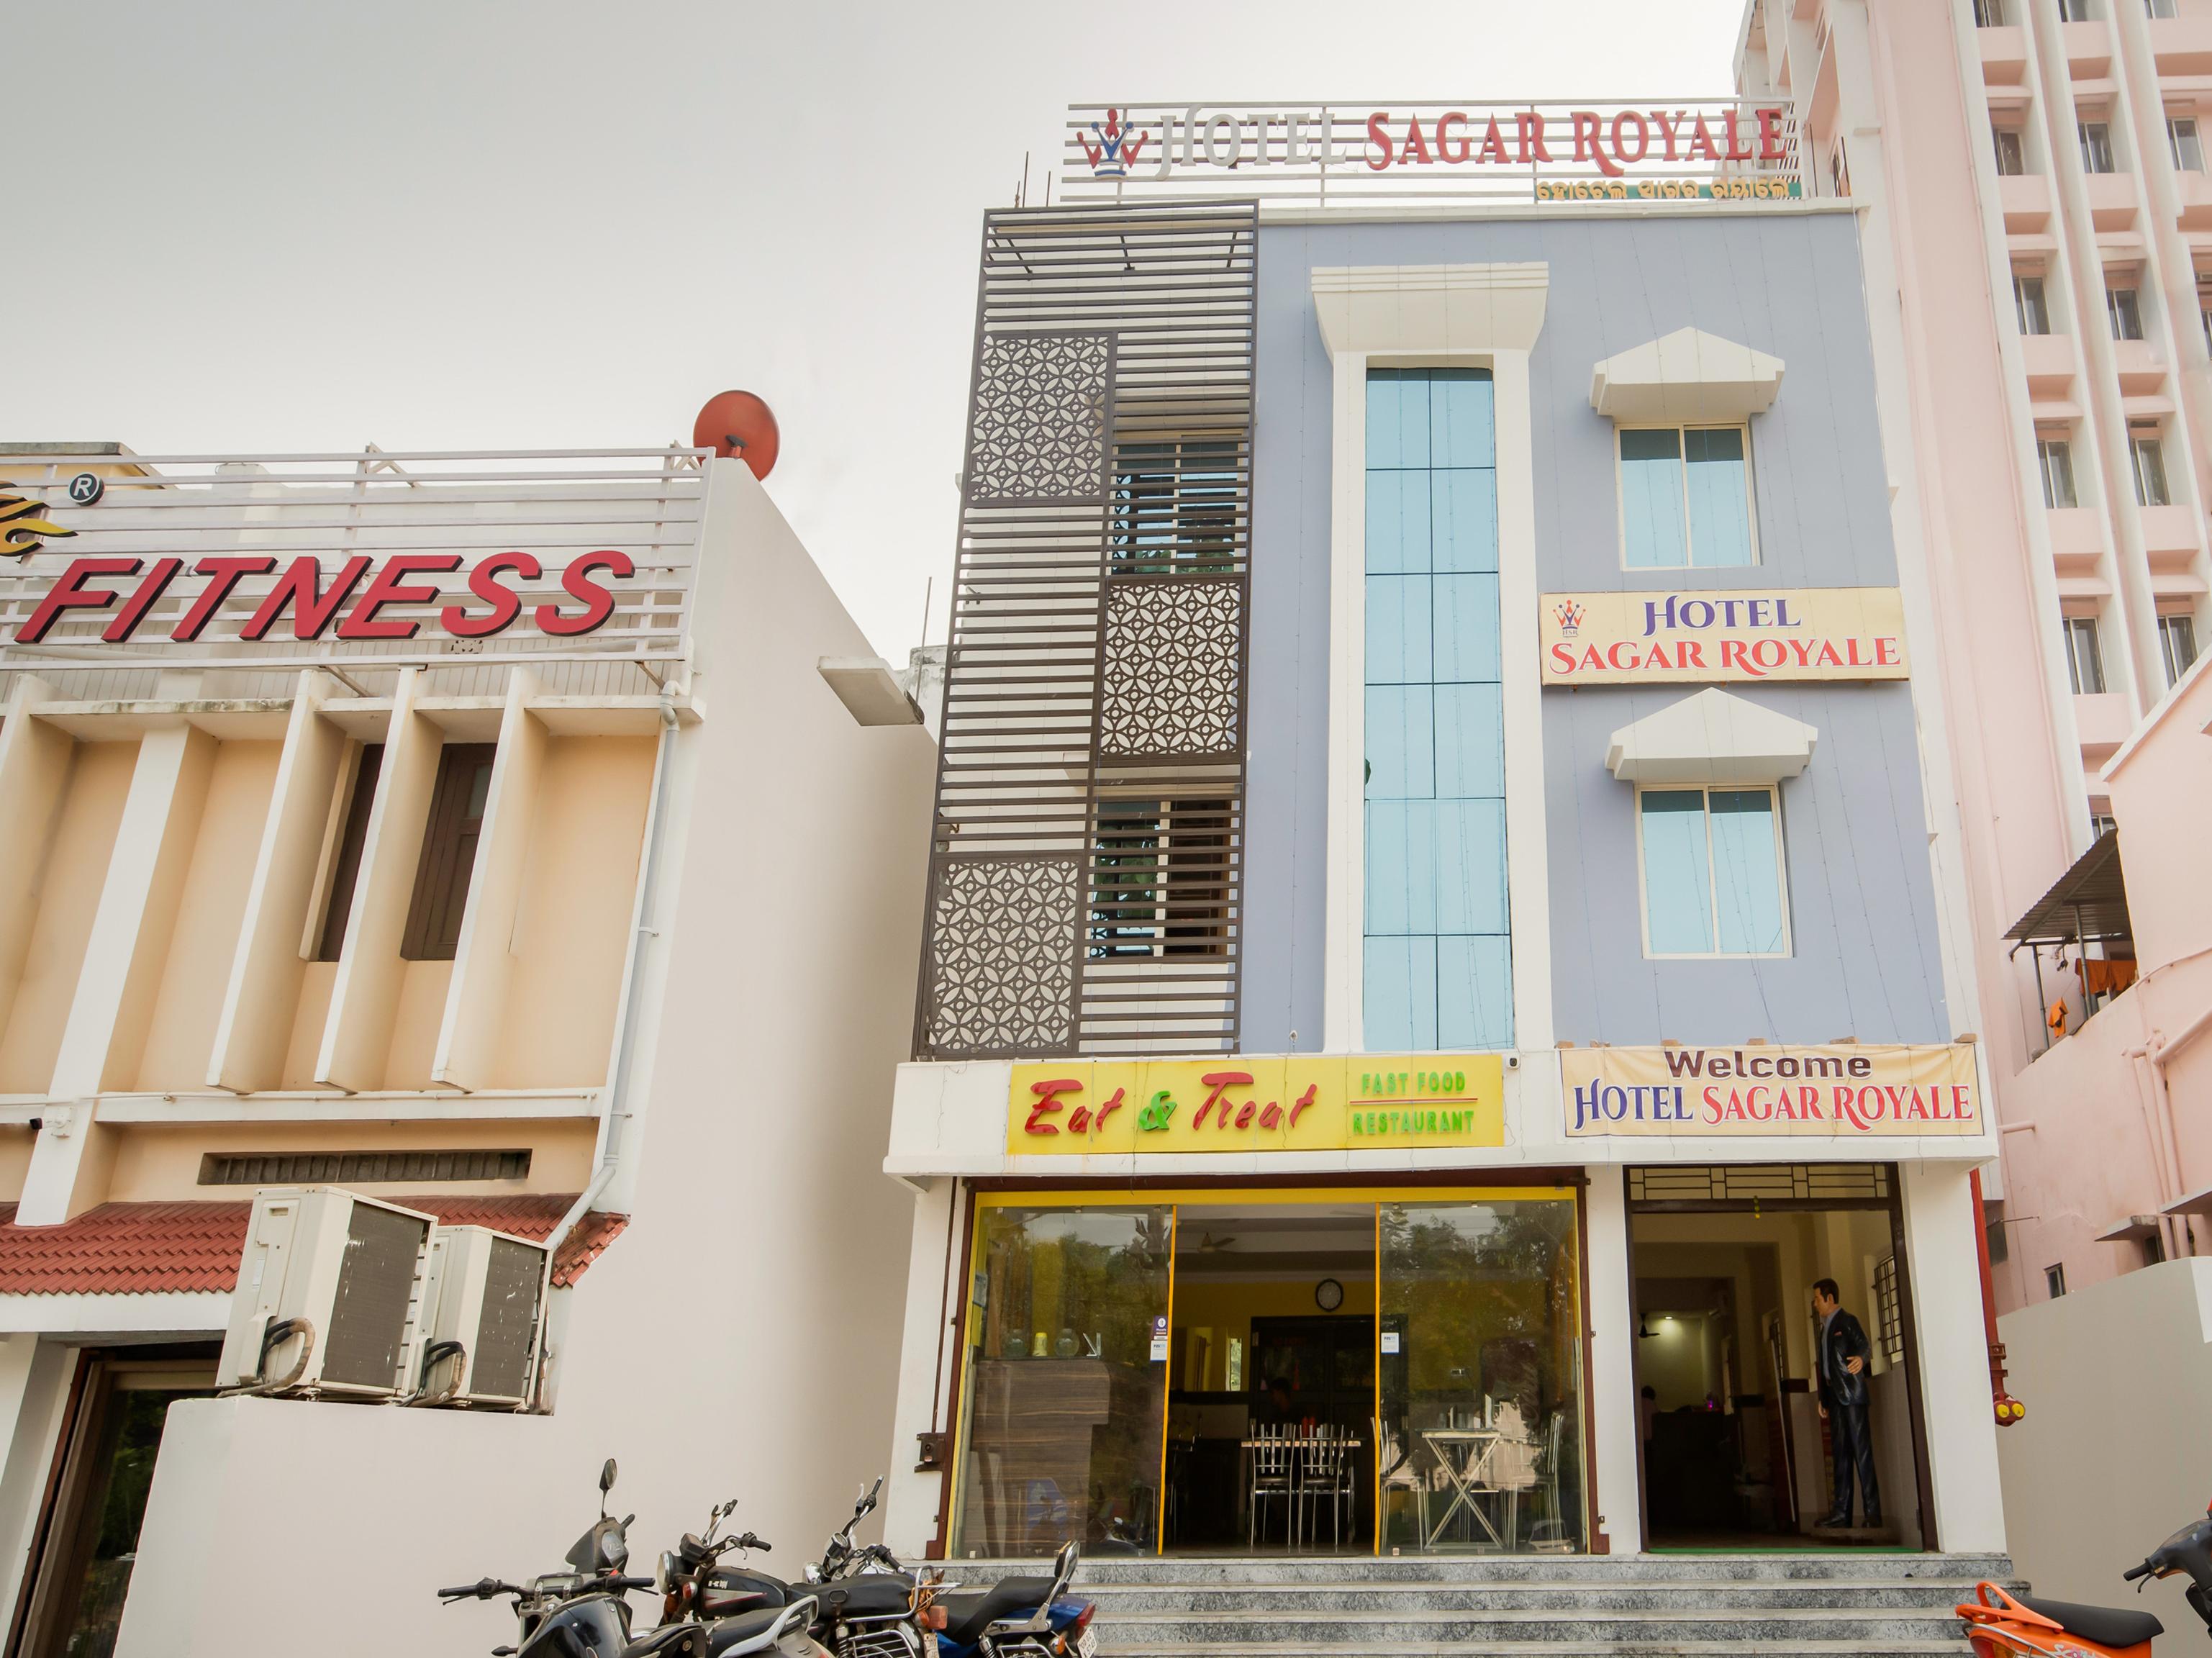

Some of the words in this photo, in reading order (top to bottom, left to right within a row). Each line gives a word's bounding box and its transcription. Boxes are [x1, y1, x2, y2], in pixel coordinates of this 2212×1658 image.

[1155, 103, 1347, 181] HOTEL
[1365, 109, 1554, 171] SAGAR
[1572, 108, 1787, 177] ROYALE
[14, 550, 635, 644] FITNESS
[1641, 594, 1802, 637] HOTEL
[1549, 640, 1709, 675] SAGAR
[1721, 637, 1902, 676] ROYALE
[1361, 1072, 1409, 1095] FAST
[1417, 1071, 1466, 1093] FOOD
[1664, 1050, 1872, 1079] Welcome
[1025, 1079, 1125, 1134] Eat
[1138, 1090, 1177, 1131] &
[1192, 1072, 1318, 1131] Treat
[1352, 1110, 1475, 1135] RESTAURANT
[1574, 1079, 1694, 1131] HOTEL
[1702, 1085, 1824, 1125] SAGAR
[1833, 1084, 1974, 1131] ROYALE
